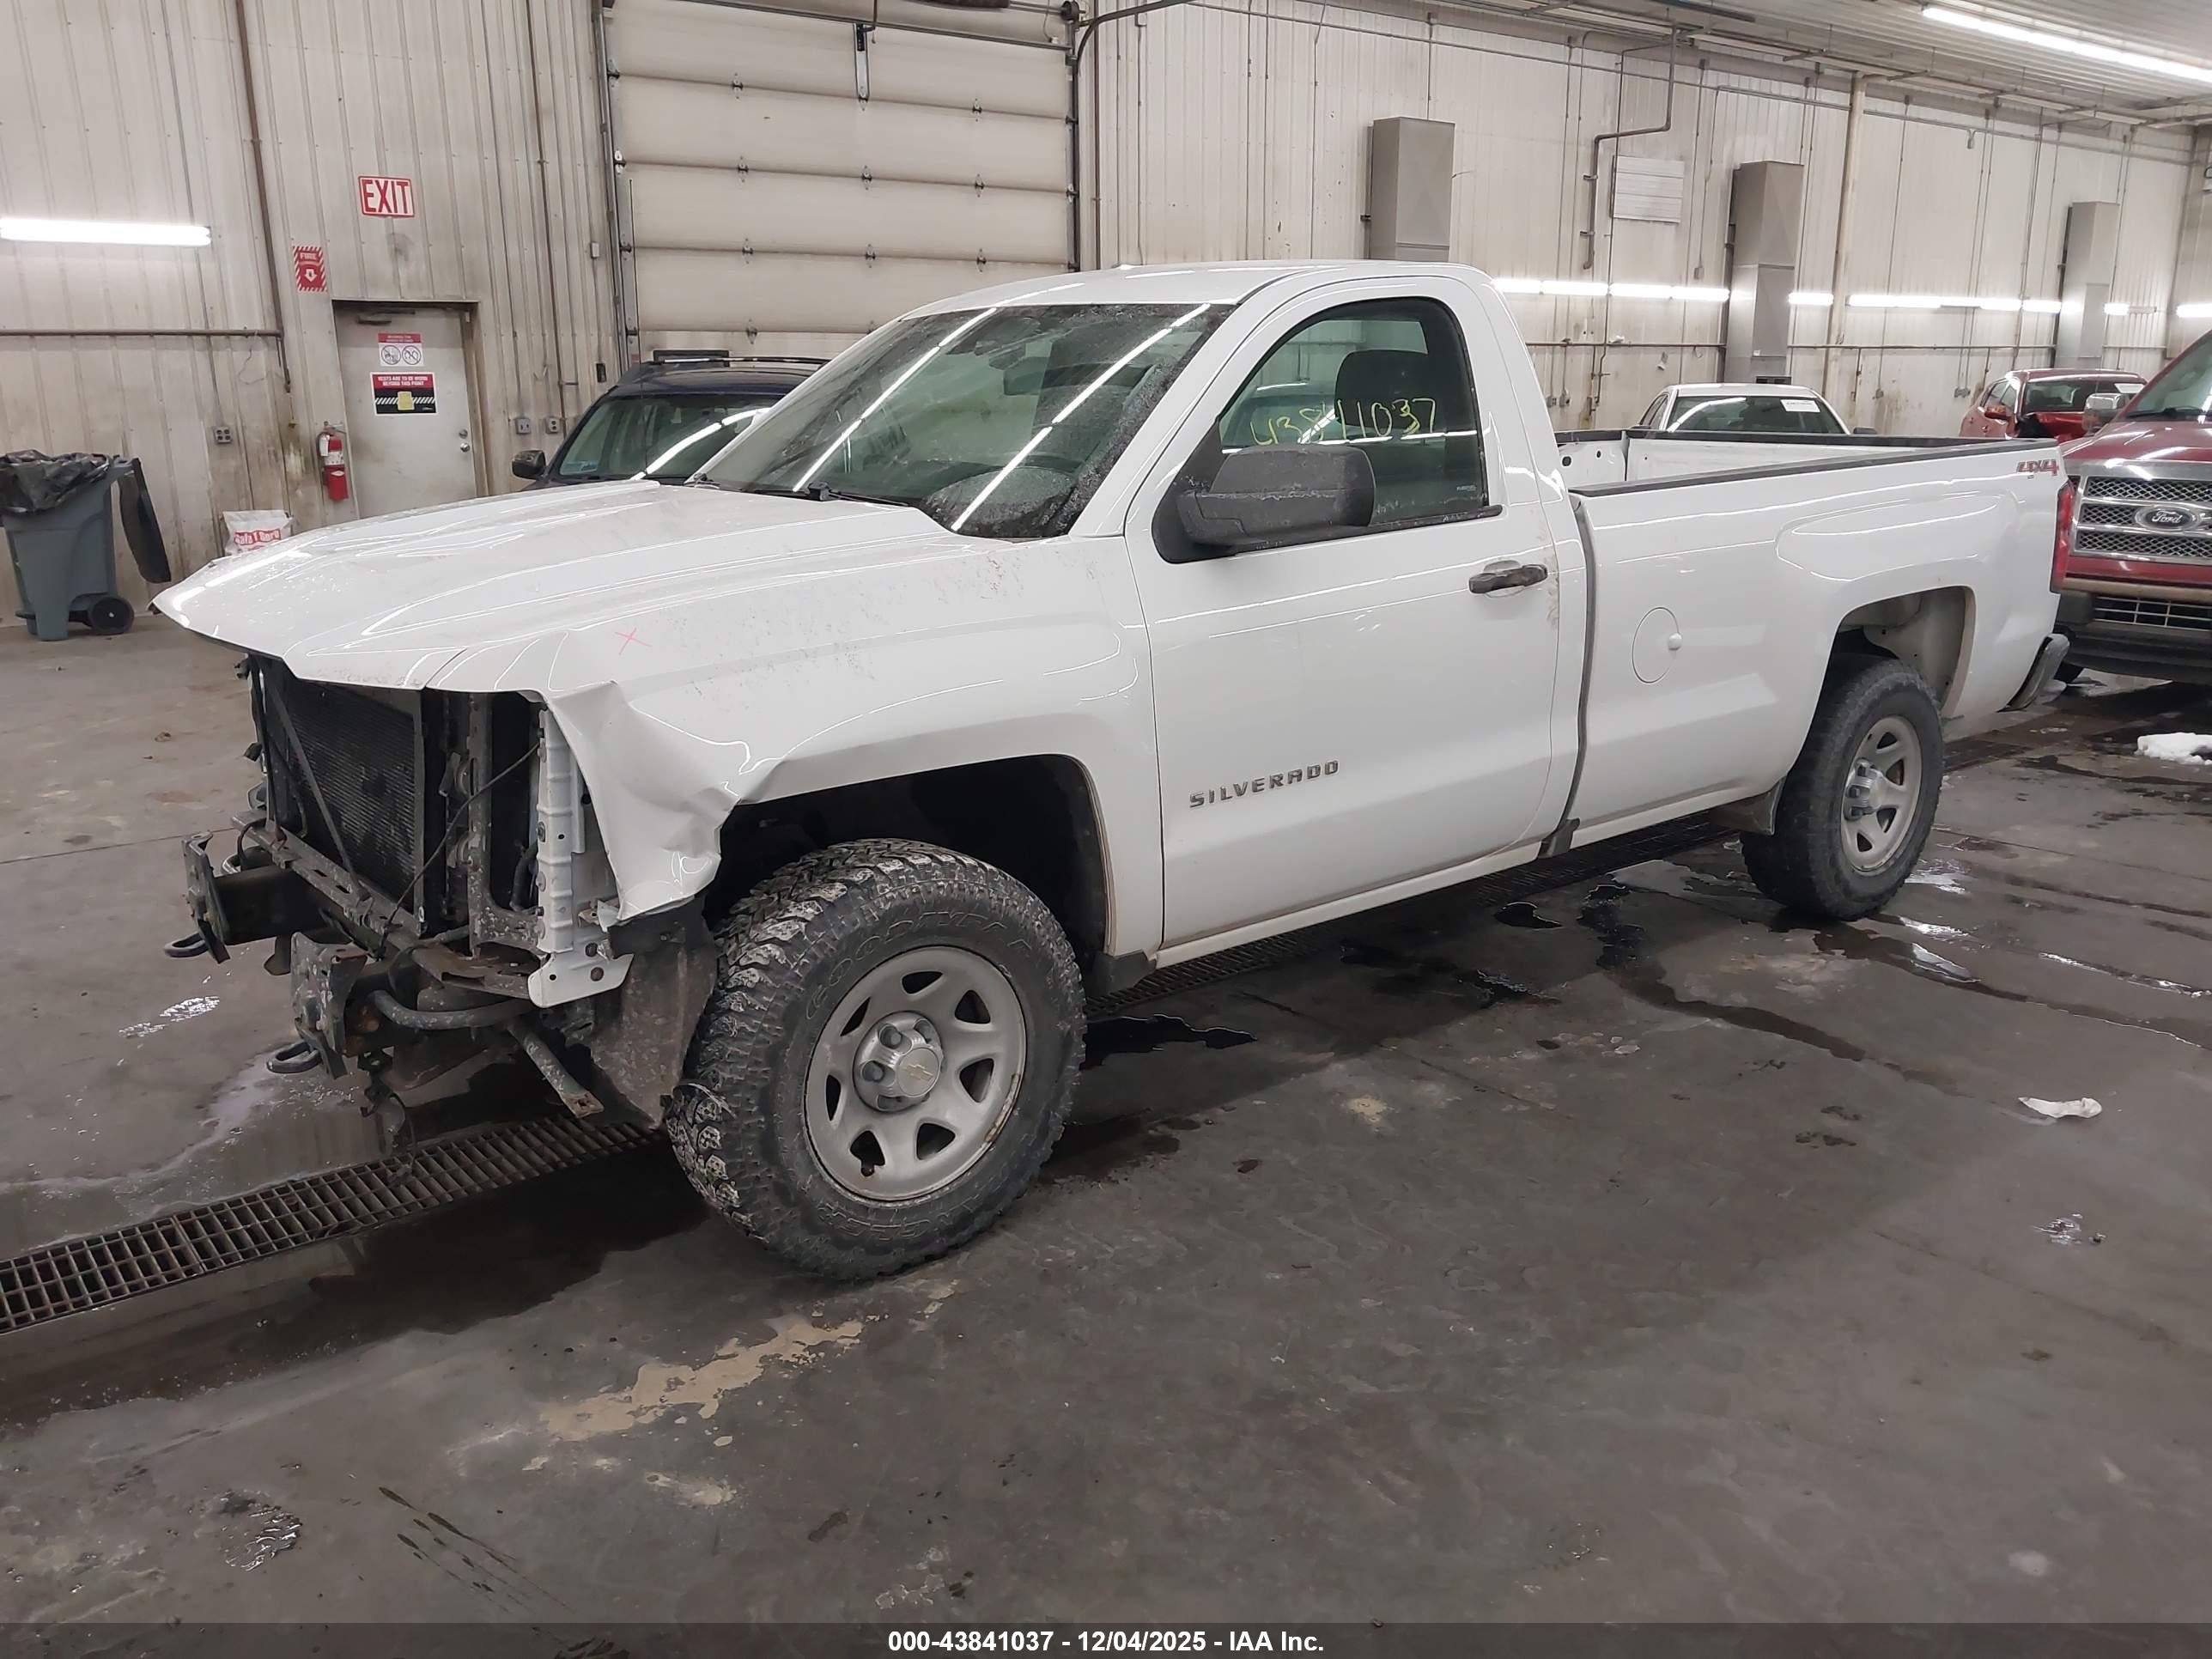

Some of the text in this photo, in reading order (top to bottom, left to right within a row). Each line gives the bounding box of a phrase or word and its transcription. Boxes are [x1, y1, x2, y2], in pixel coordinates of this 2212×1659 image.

[362, 179, 409, 214] EXIT
[2152, 510, 2184, 524] Ford
[1189, 760, 1340, 808] SILVERADO
